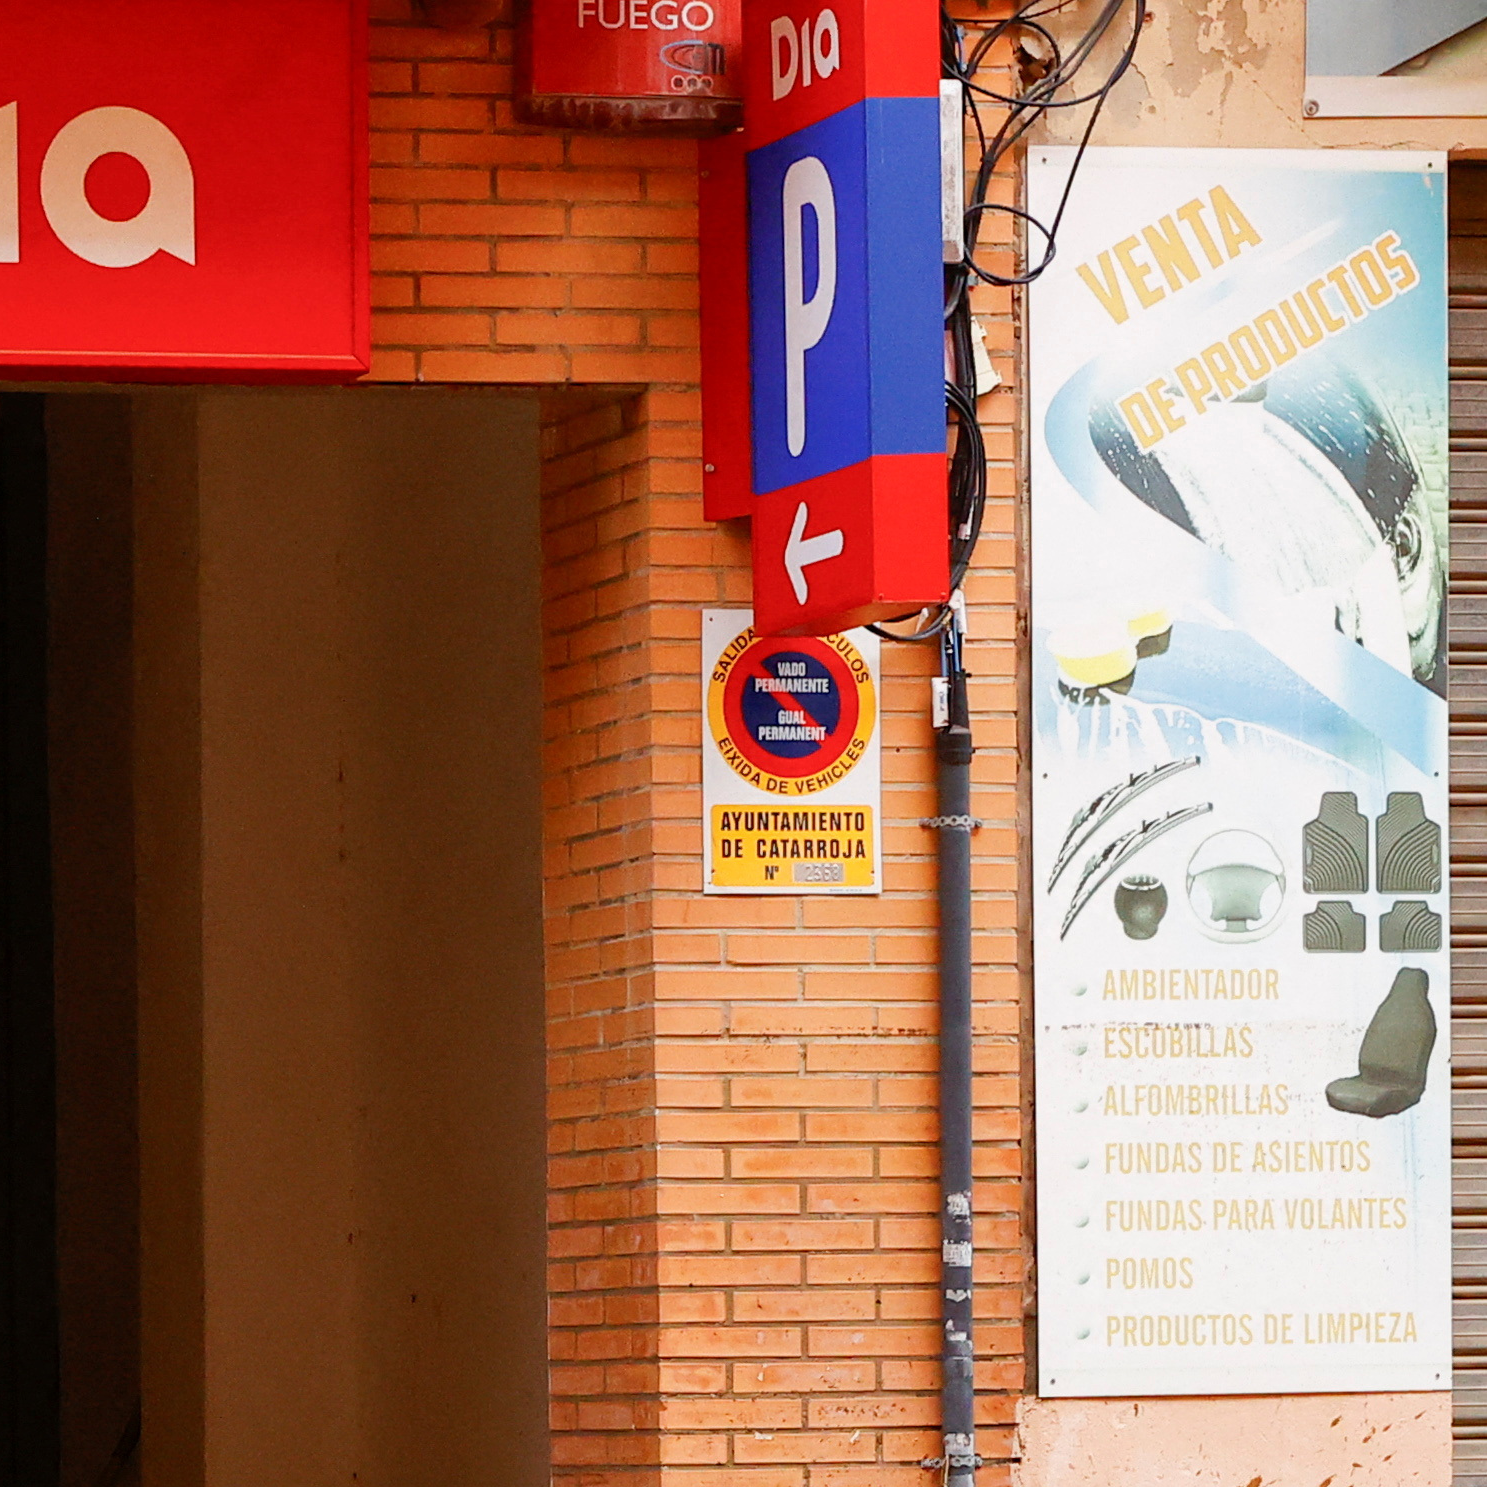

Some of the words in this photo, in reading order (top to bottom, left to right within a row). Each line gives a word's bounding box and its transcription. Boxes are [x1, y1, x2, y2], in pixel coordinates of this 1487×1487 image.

[577, 0, 714, 31] FUEGO
[1075, 185, 1264, 325] VENTA
[782, 156, 837, 457] P
[1118, 377, 1187, 450] DE
[1174, 234, 1418, 416] PRODUCTOS
[778, 662, 806, 676] VADO
[827, 633, 869, 684] CULOS
[755, 679, 829, 693] PERMANENTE
[758, 727, 826, 741] PERMANENT
[778, 711, 806, 725] GUAL
[718, 737, 760, 786] EIXIDA
[767, 780, 788, 794] DE
[795, 737, 865, 794] VEHICLES
[721, 812, 865, 831] AYUNTAMIENTO
[722, 840, 743, 858] DE
[757, 839, 866, 859] CATARROJA
[1102, 968, 1279, 1000] AMBIENTADOR
[1104, 1026, 1254, 1059] ESCOBILLAS
[1103, 1084, 1289, 1116] ALFOMBRILLAS
[1105, 1142, 1203, 1174] FUNDAS
[1212, 1141, 1243, 1173] DE
[1254, 1140, 1371, 1172] ASIENTOS
[1106, 1200, 1203, 1231] FUNDAS
[1213, 1199, 1275, 1230] PARA
[1284, 1197, 1408, 1230] VOLANTES
[1106, 1257, 1194, 1289] POMOS
[1106, 1314, 1254, 1346] PRODUCTOS
[1263, 1313, 1294, 1344] DE
[1304, 1312, 1418, 1343] LIMPIEZA
